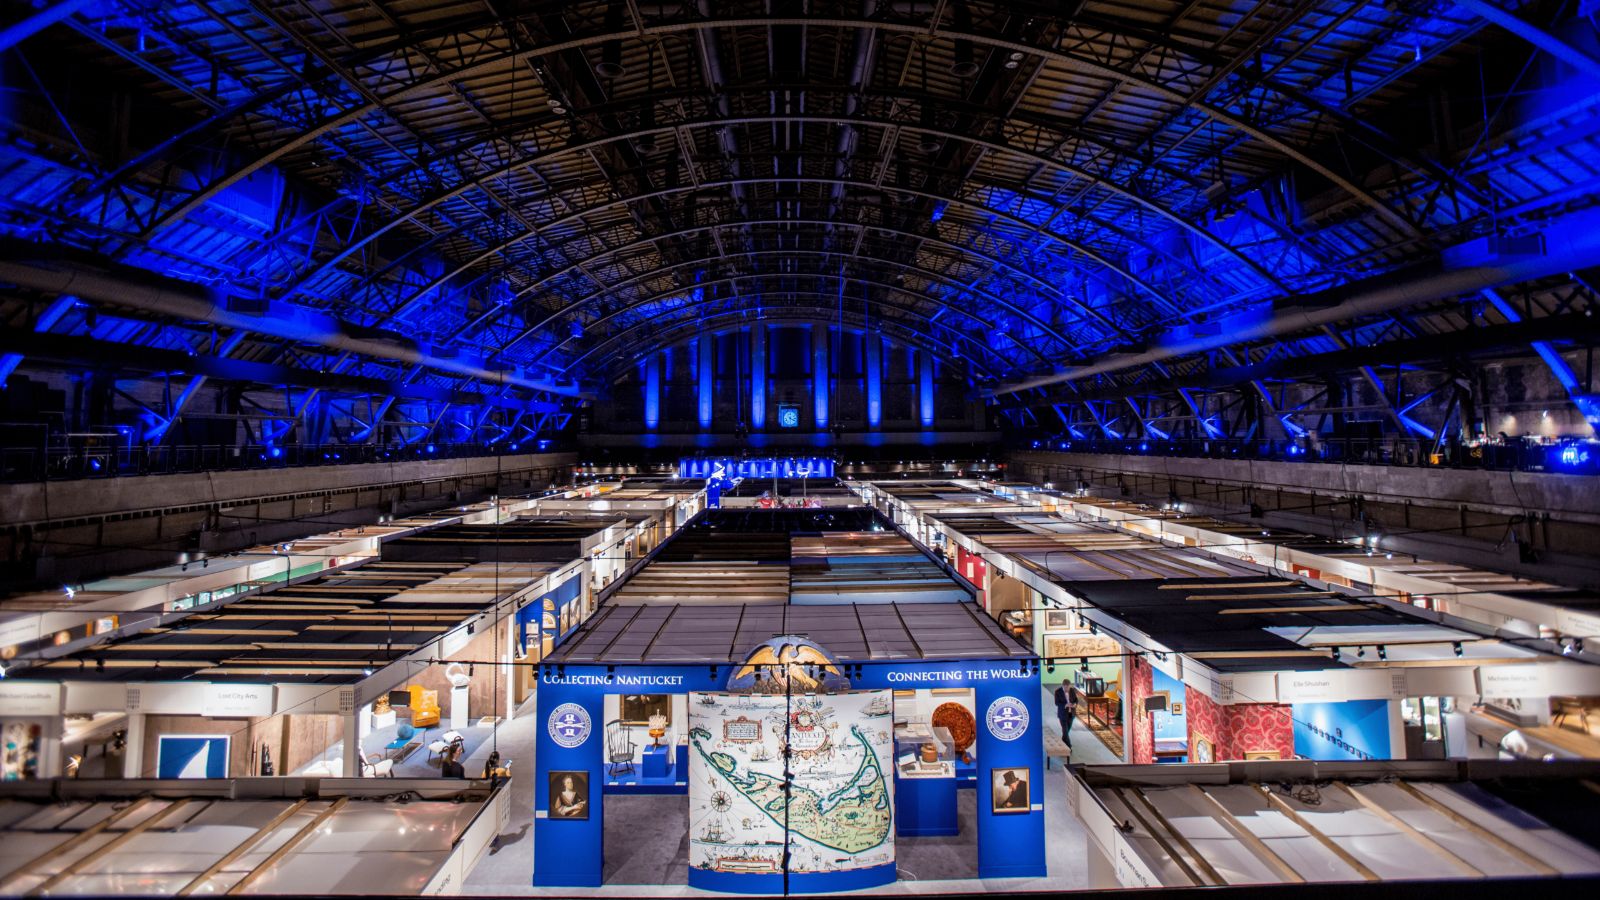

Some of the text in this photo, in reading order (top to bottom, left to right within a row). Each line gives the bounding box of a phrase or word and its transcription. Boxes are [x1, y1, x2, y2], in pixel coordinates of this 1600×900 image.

[543, 674, 684, 686] COLLECTING NANTUCKET
[887, 669, 1032, 682] CONNECTING THE WORLD
